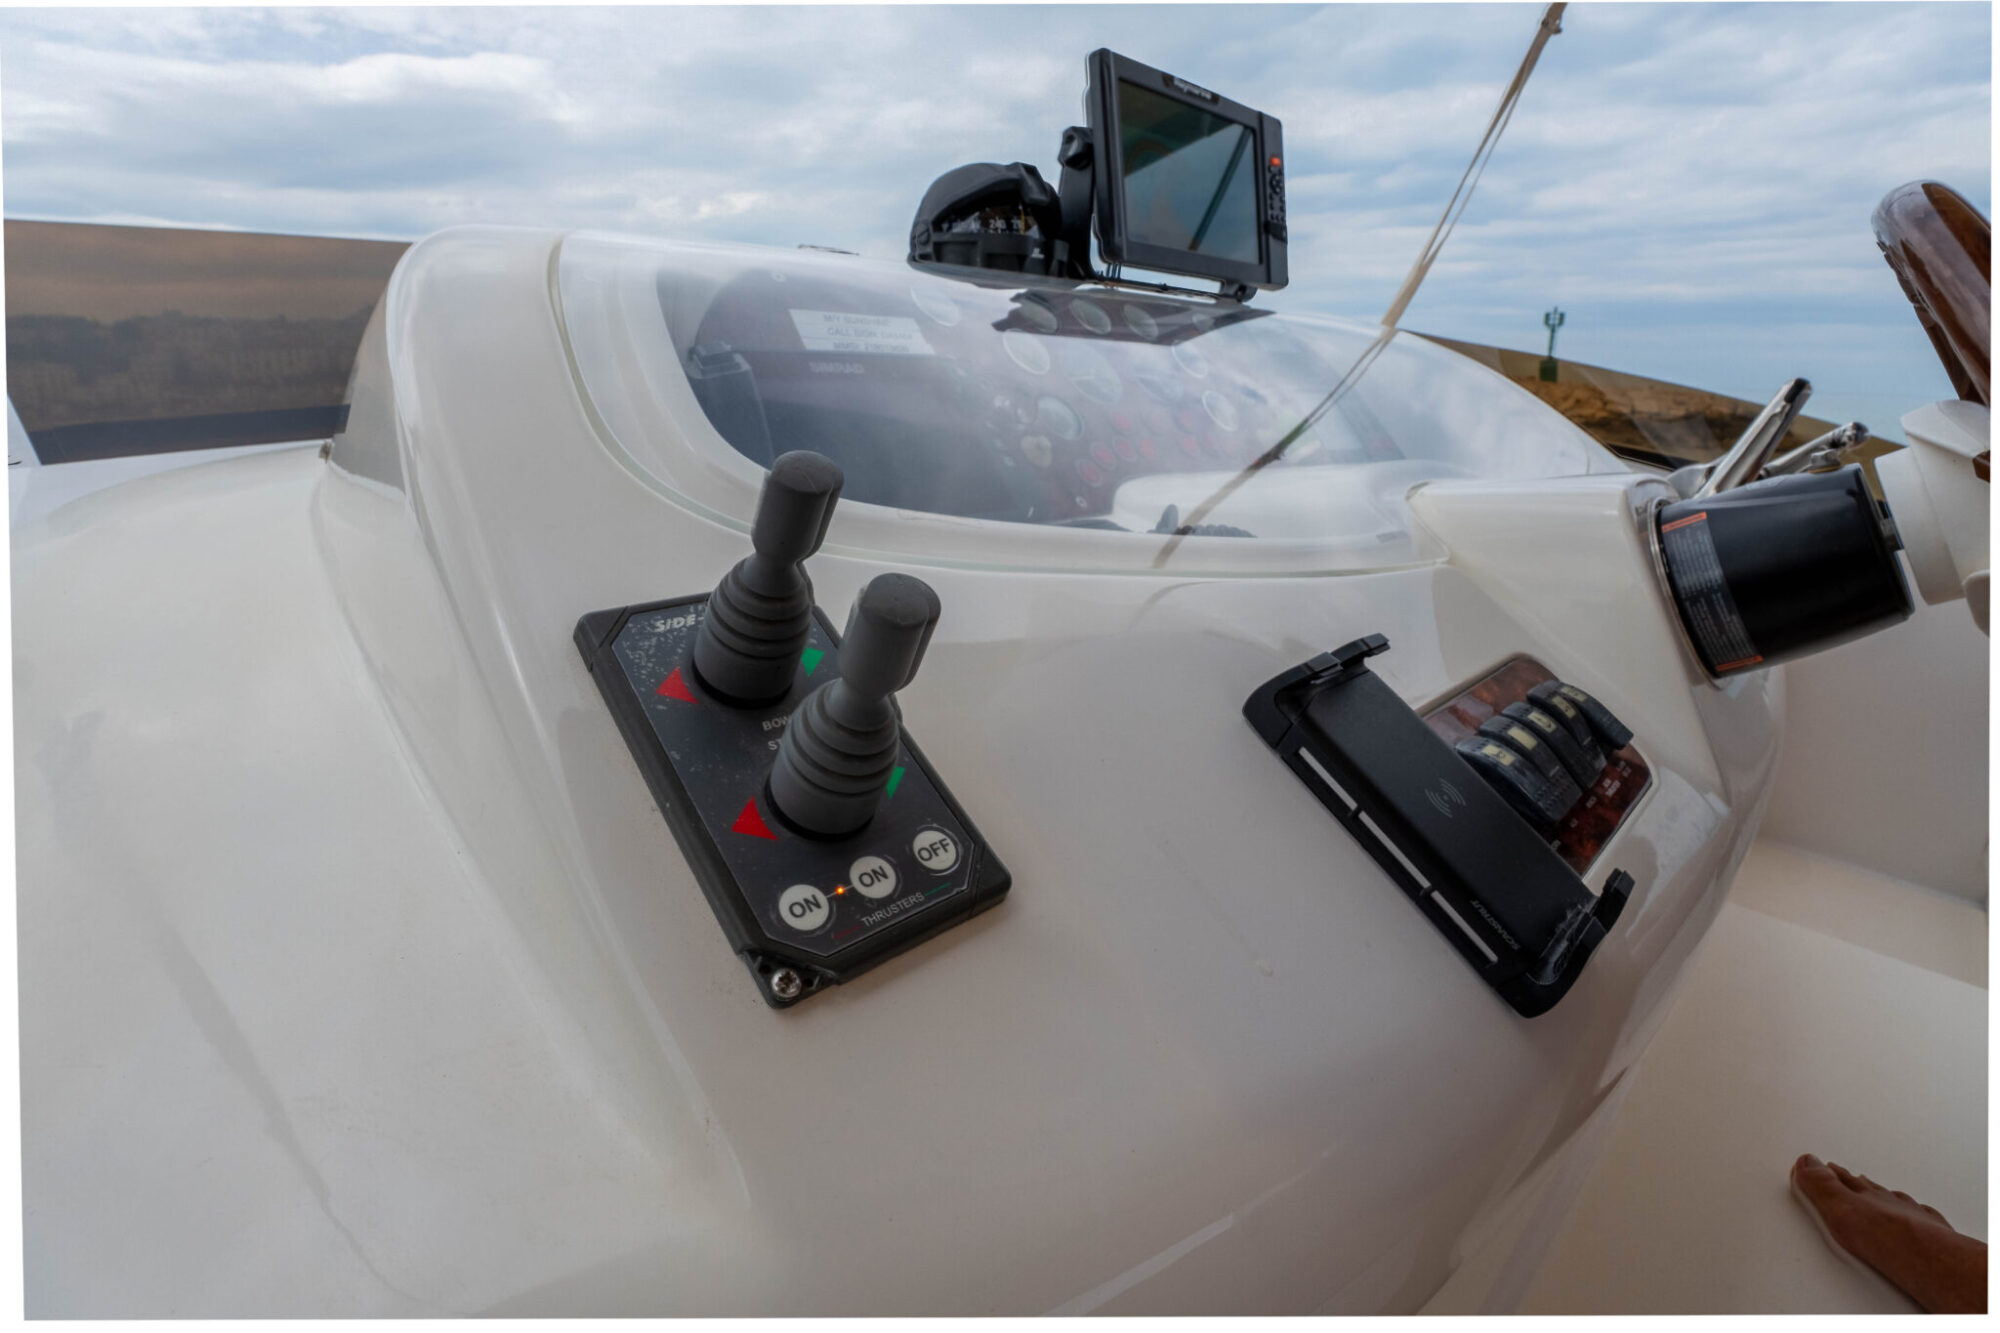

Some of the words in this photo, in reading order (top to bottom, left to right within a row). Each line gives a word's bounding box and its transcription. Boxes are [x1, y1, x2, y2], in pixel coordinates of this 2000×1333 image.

[827, 327, 852, 337] CALL
[917, 838, 950, 862] OFF
[858, 865, 889, 888] ON
[788, 894, 822, 919] ON
[861, 891, 925, 928] THRUSTERS
